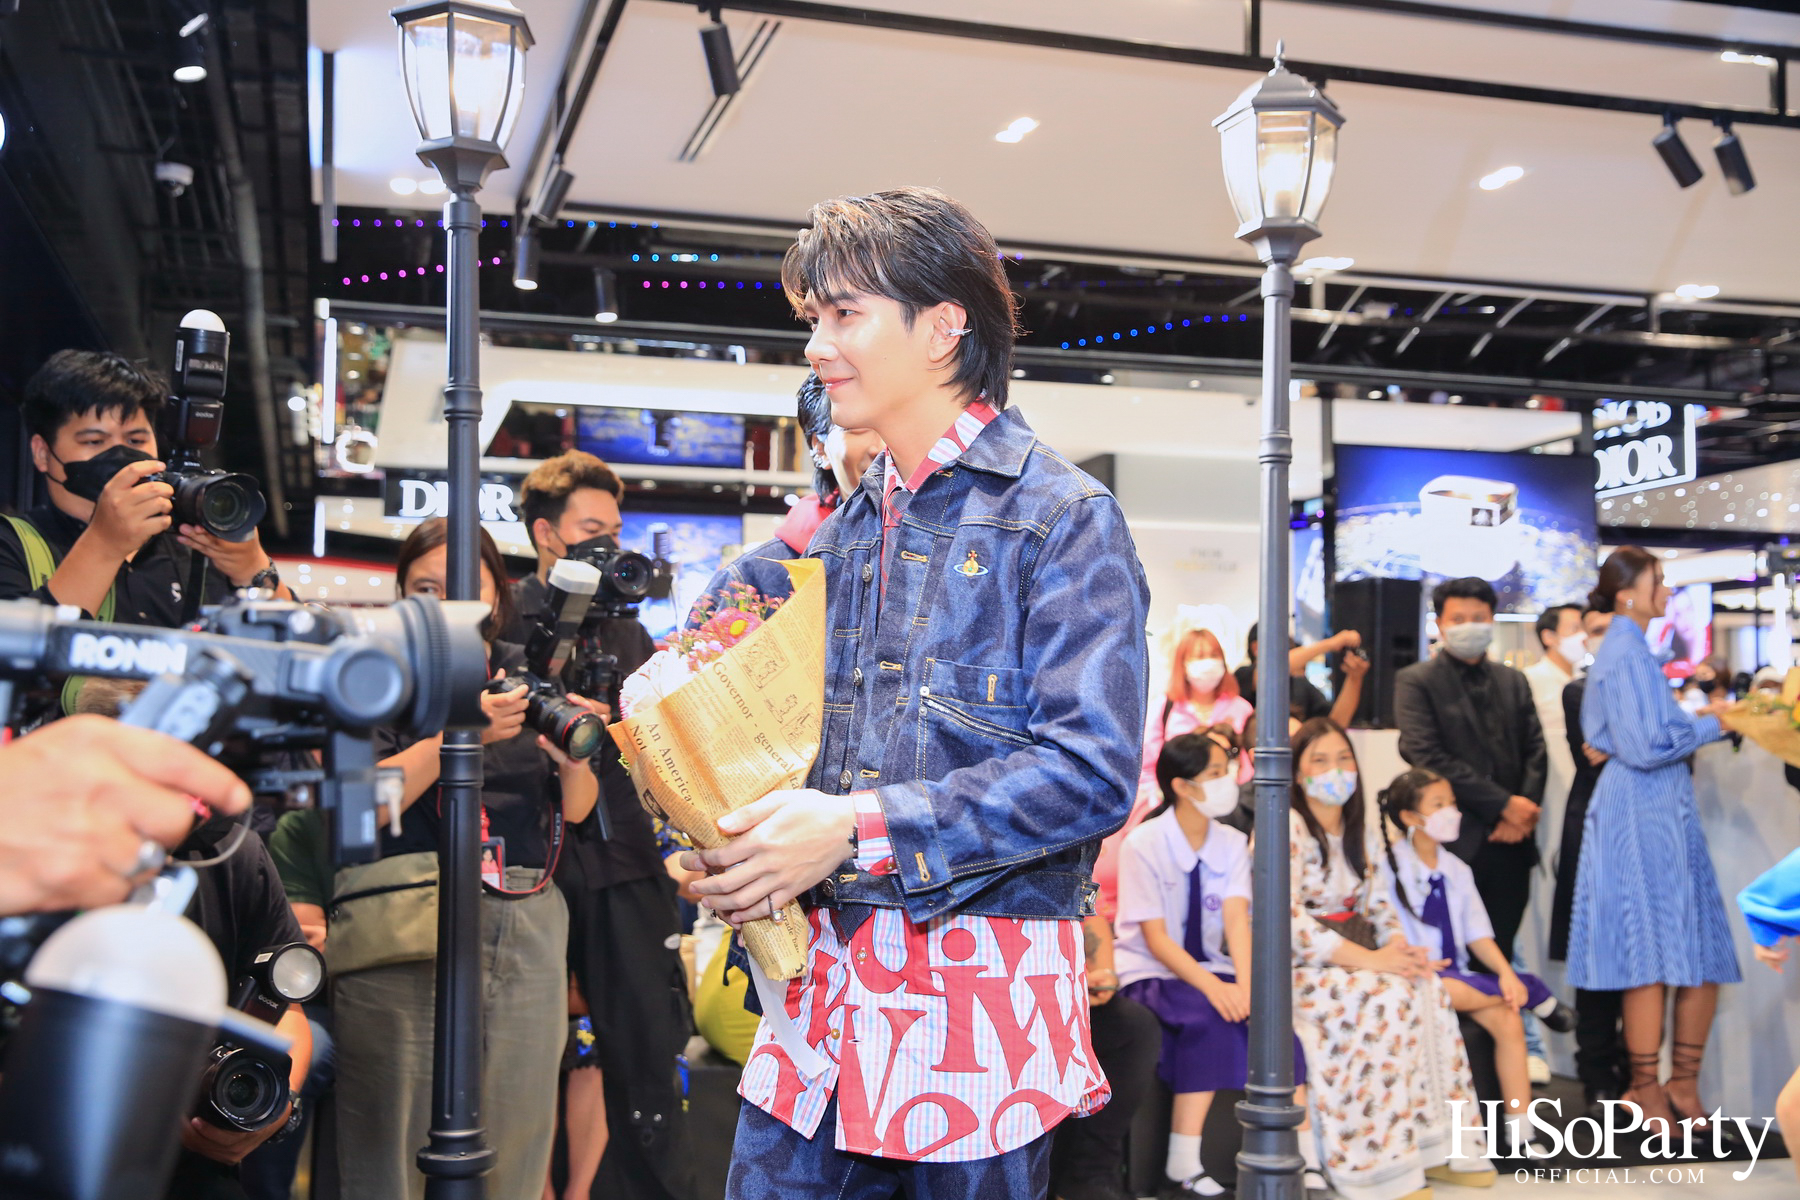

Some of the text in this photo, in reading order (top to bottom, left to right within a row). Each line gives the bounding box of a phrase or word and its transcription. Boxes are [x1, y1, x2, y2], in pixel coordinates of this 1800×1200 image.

[399, 479, 518, 522] DIR
[69, 632, 188, 675] RONIN
[713, 662, 754, 719] Governor
[753, 732, 795, 773] general
[647, 722, 695, 806] An America
